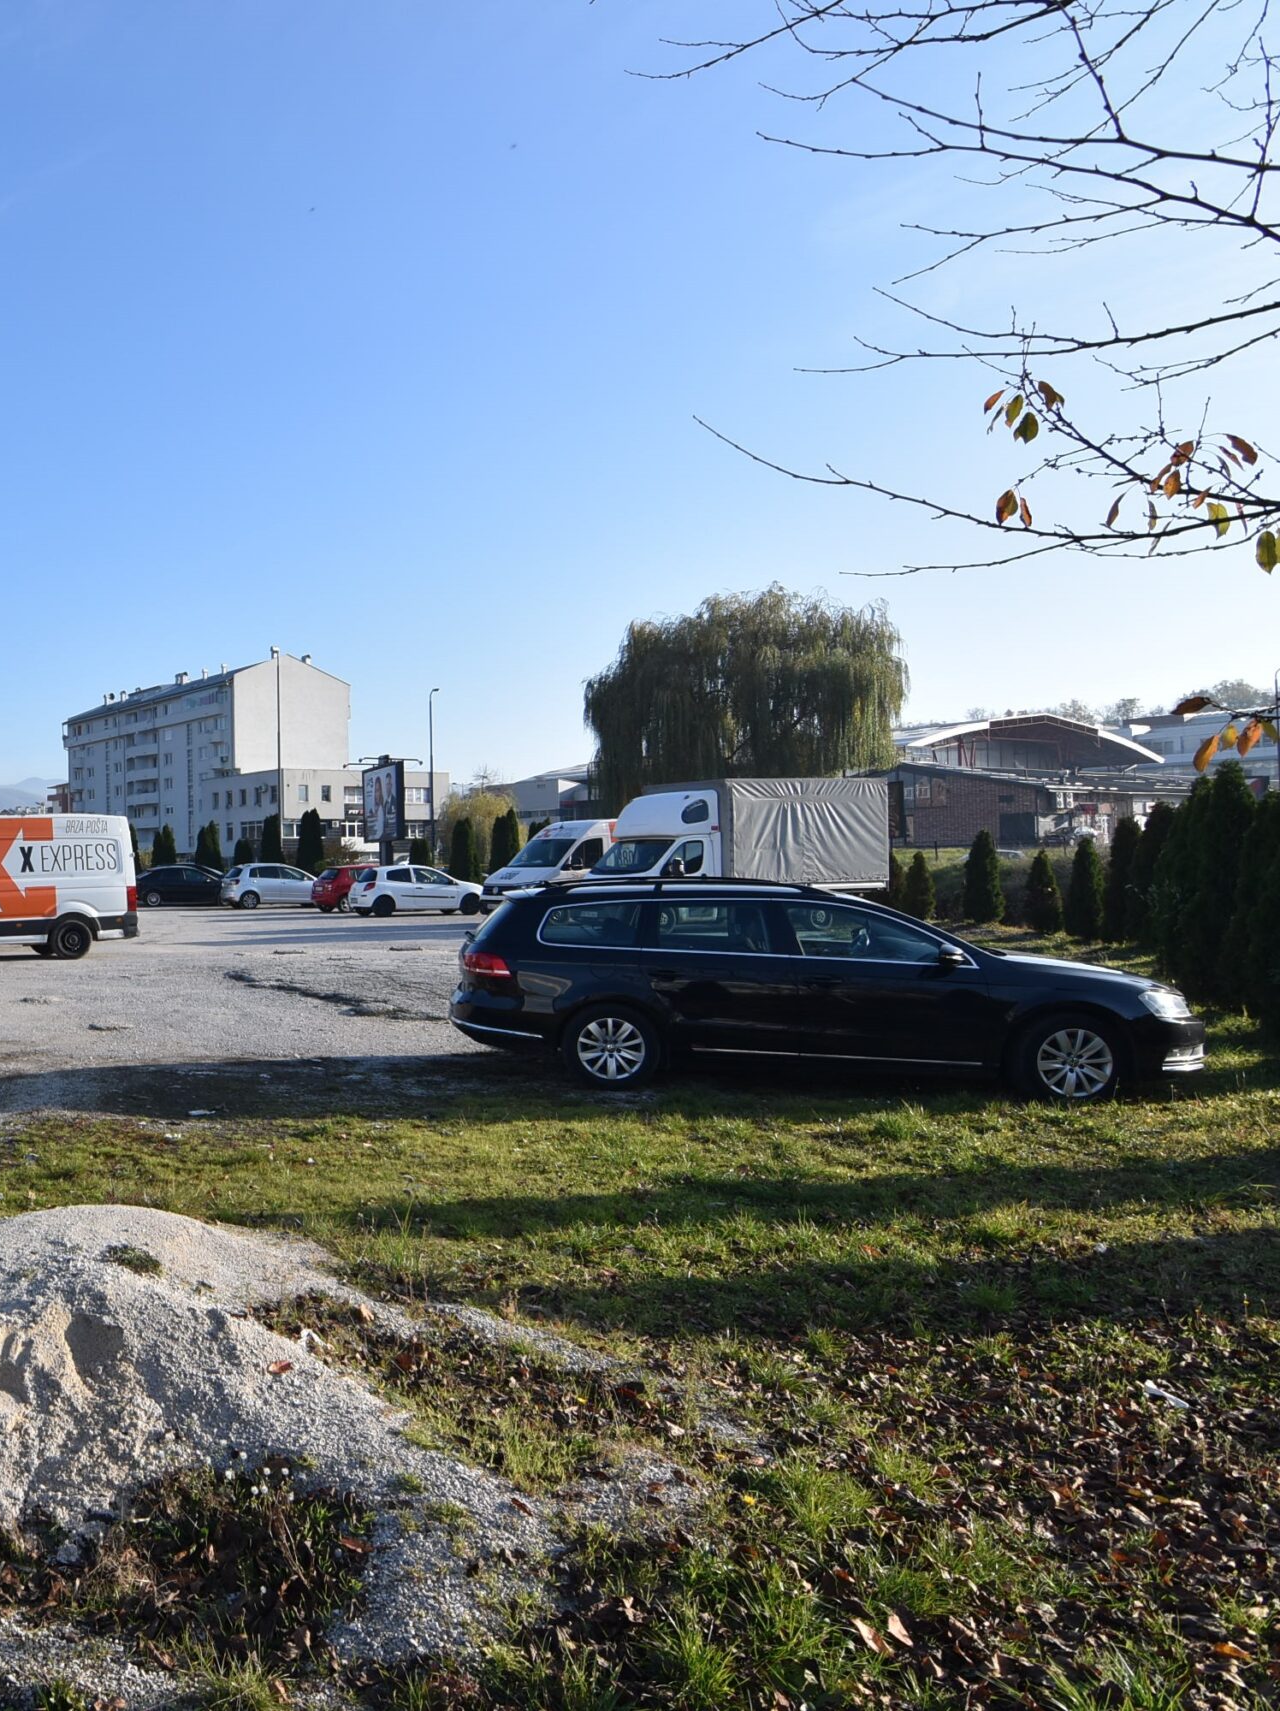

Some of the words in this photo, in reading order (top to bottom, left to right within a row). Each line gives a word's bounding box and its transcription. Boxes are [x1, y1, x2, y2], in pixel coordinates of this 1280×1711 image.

[66, 819, 84, 834] BRZA
[86, 817, 108, 834] POŠTA
[19, 846, 35, 873] X
[40, 843, 118, 873] EXPRESS
